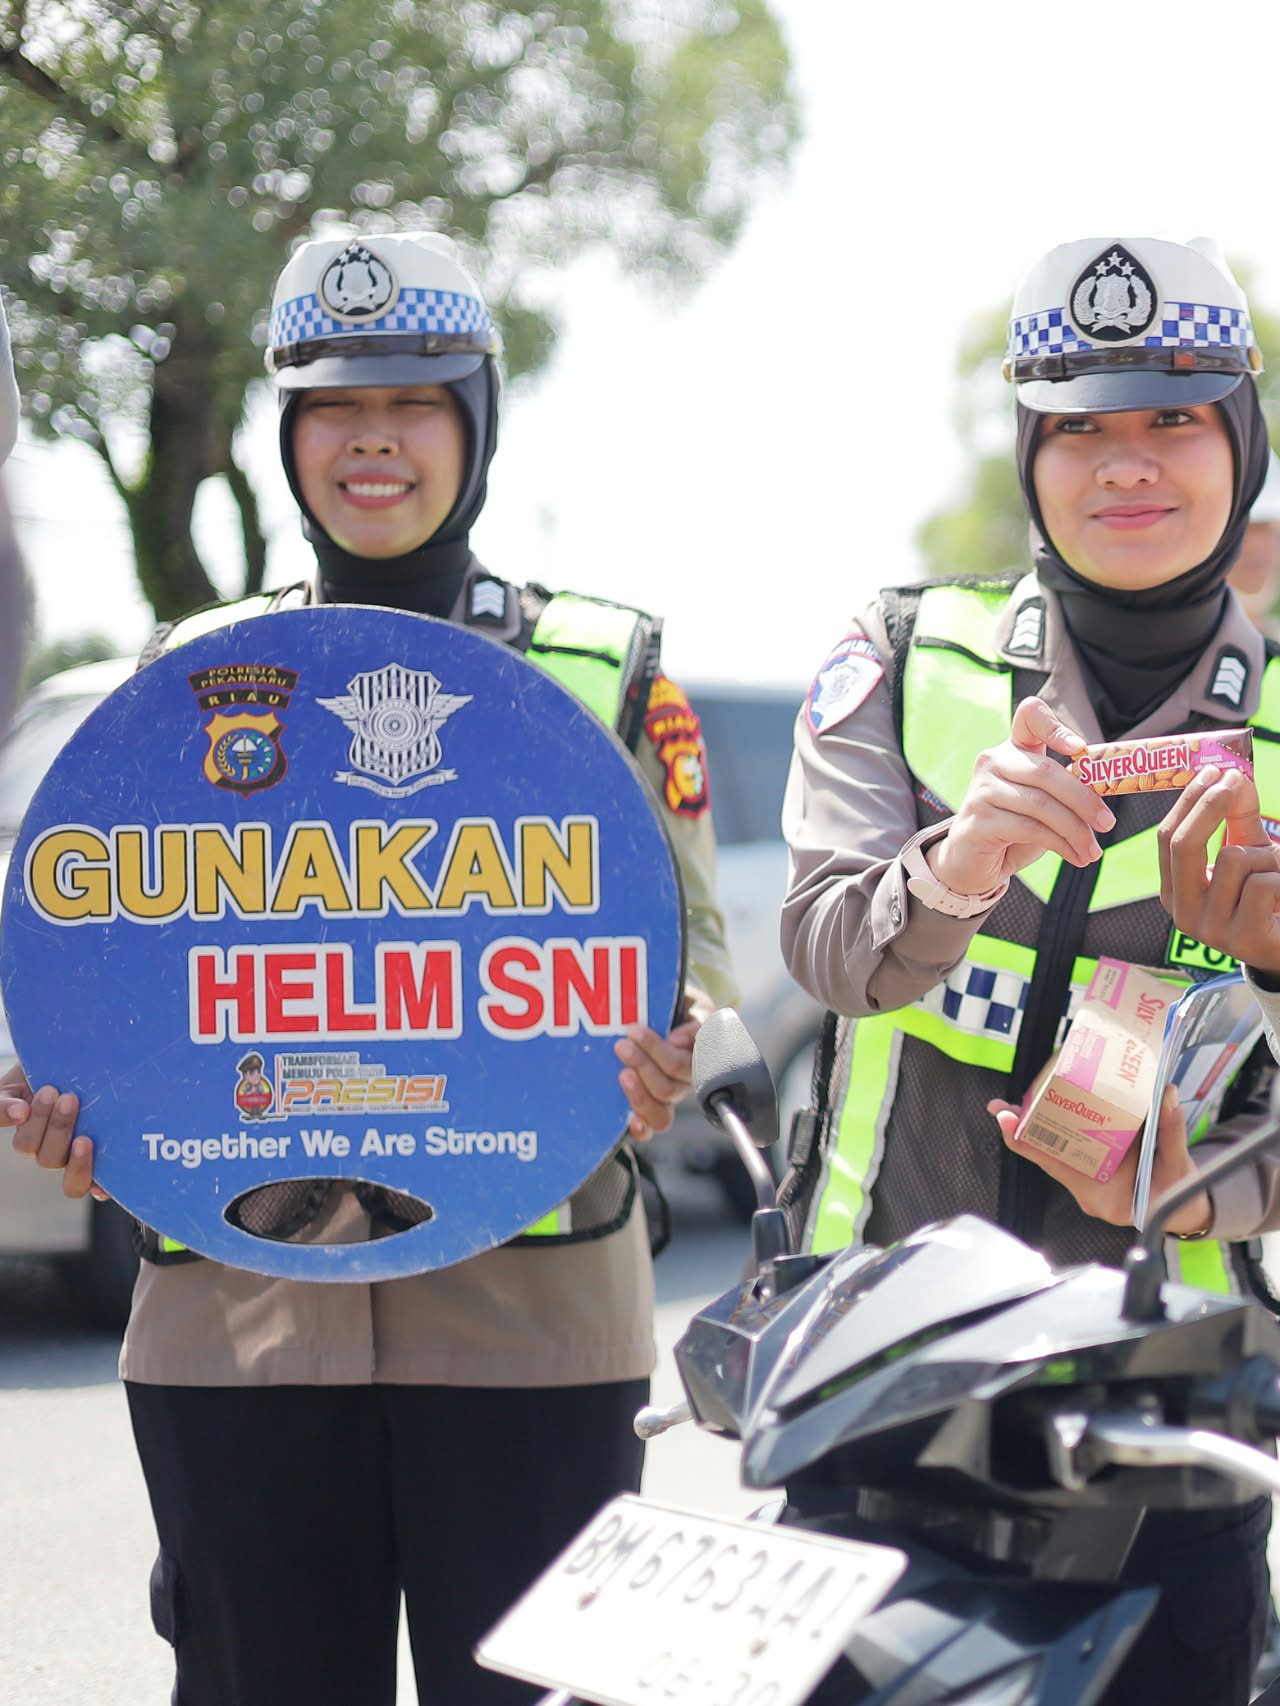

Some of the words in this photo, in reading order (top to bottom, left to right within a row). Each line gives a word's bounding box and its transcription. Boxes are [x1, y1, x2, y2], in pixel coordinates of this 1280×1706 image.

[201, 674, 287, 689] PEKANBARU
[208, 667, 277, 678] POLRESTA
[208, 692, 280, 707] RIAU
[28, 820, 596, 921] GUNAKAN
[195, 948, 457, 1037] HELM
[484, 944, 641, 1033] SNI
[284, 1077, 445, 1105] PRESISI
[142, 1131, 291, 1168] Together
[301, 1129, 351, 1157] We
[360, 1128, 417, 1156] Are
[425, 1126, 538, 1162] Strong
[562, 1513, 656, 1590] BM
[628, 1529, 768, 1614] 6763
